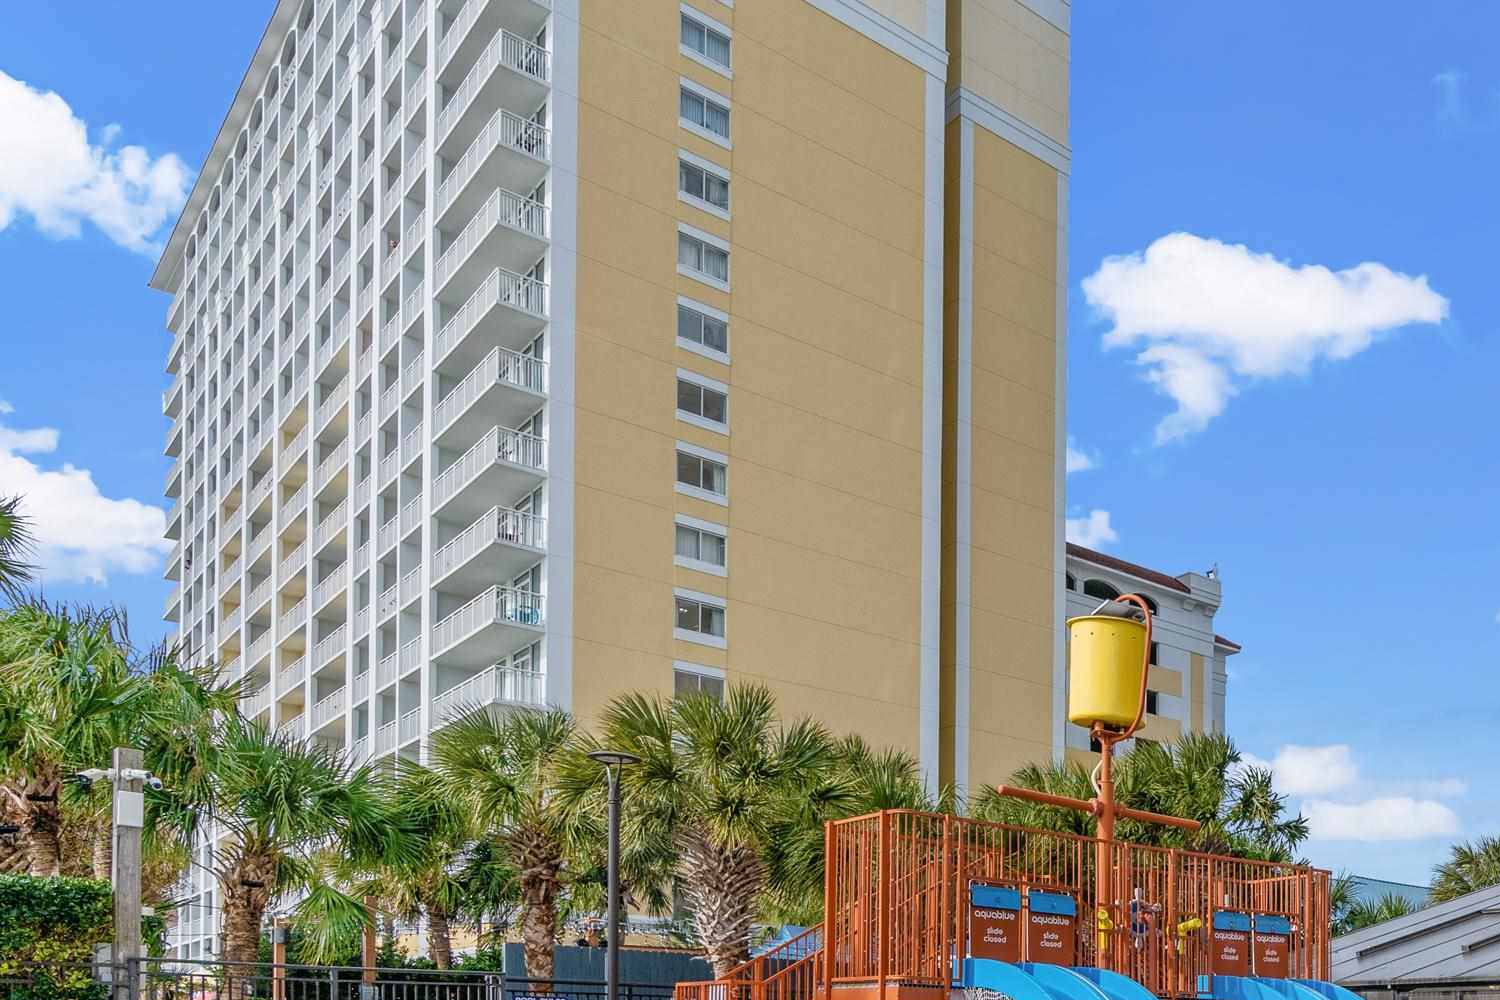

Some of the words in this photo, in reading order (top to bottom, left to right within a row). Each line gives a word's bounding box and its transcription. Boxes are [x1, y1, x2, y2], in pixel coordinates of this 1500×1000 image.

[974, 910, 1016, 921] aquablue
[1031, 915, 1071, 926] aquablue
[986, 926, 1004, 936] slide
[1043, 931, 1059, 940] slide
[983, 935, 1007, 944] closed
[1214, 932, 1245, 941] aquablue
[1256, 935, 1286, 943] aquablue
[1040, 939, 1063, 949] closed
